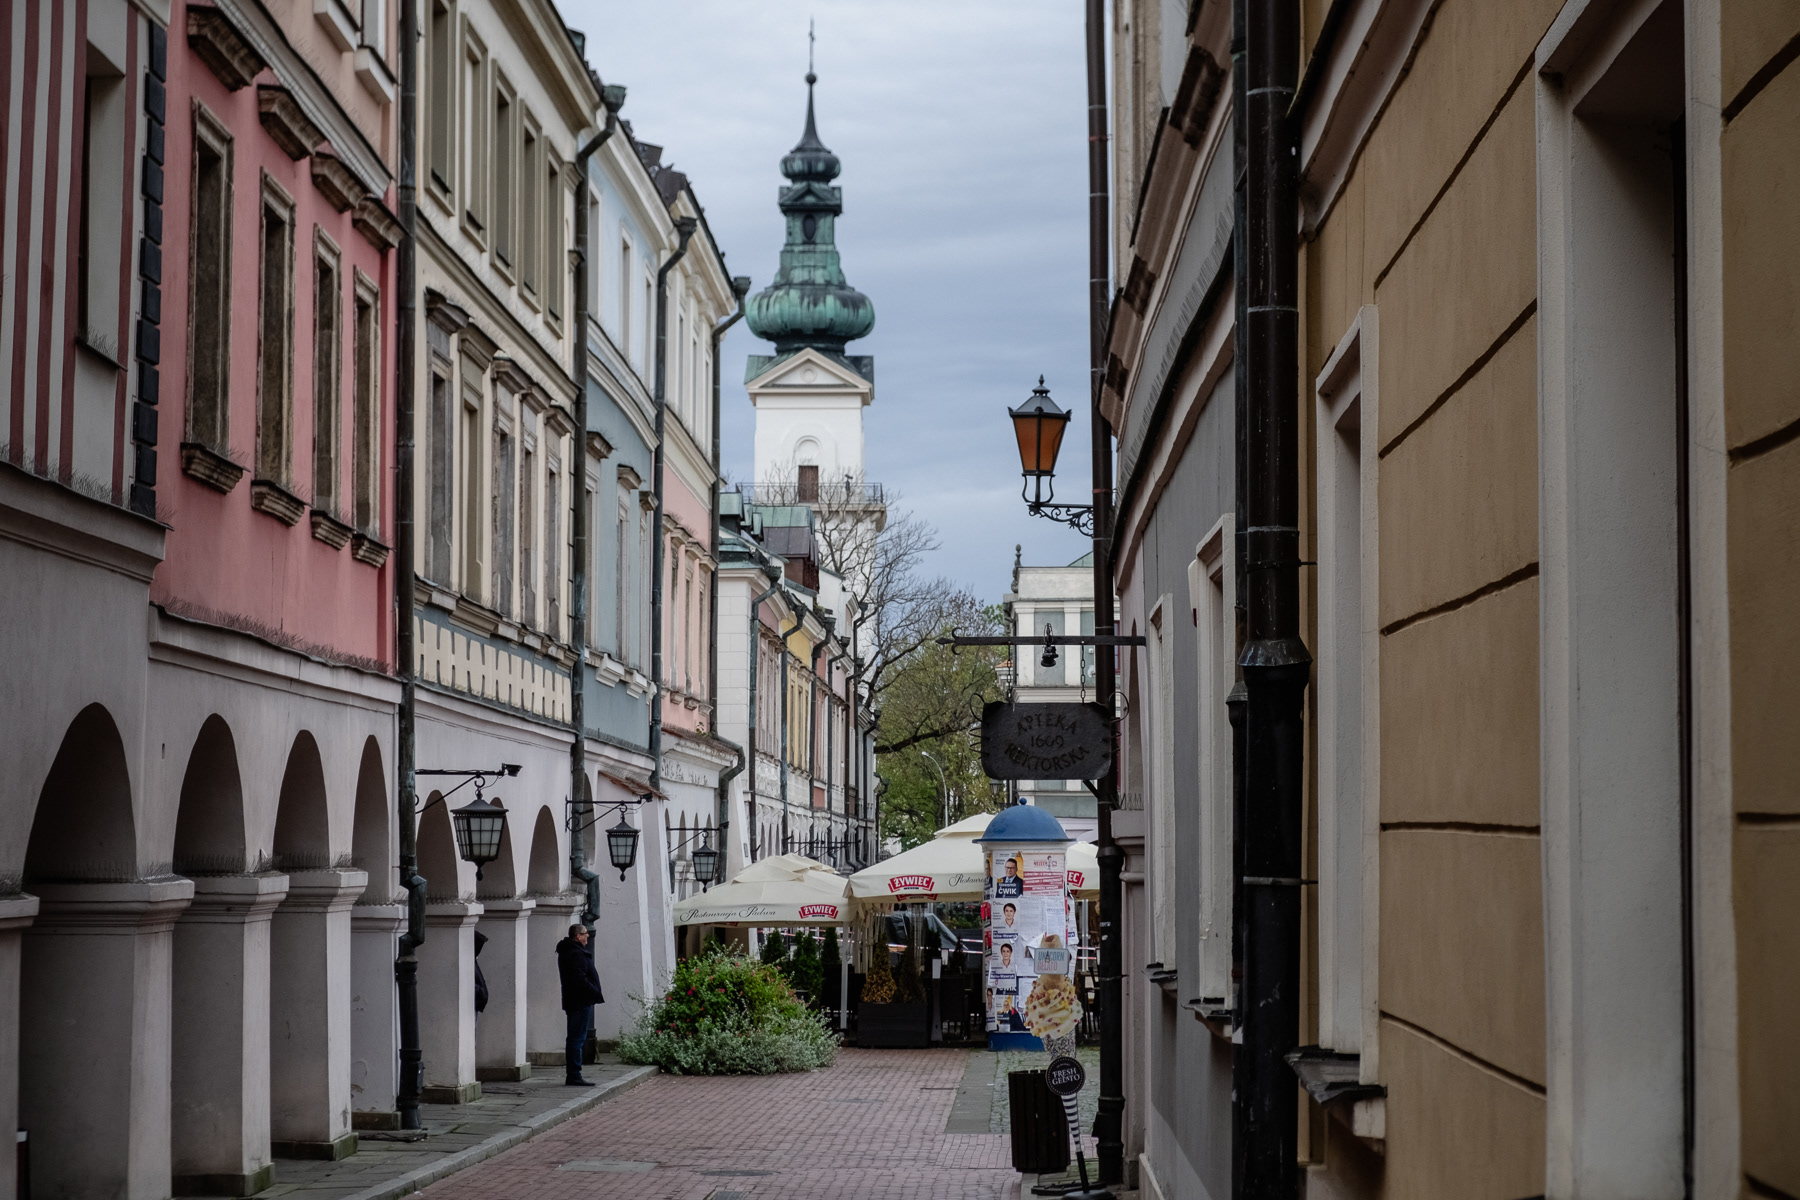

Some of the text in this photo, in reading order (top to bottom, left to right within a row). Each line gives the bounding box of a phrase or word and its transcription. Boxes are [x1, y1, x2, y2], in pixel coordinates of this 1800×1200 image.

[1017, 712, 1077, 735] APTEKA
[1004, 742, 1090, 771] REKTORSKA
[893, 876, 930, 888] ŻYWIEC
[998, 887, 1017, 895] ĆWIK
[802, 905, 835, 915] ŻYWIEC
[1052, 1067, 1077, 1078] FRESH
[1051, 1074, 1081, 1085] GELATO
